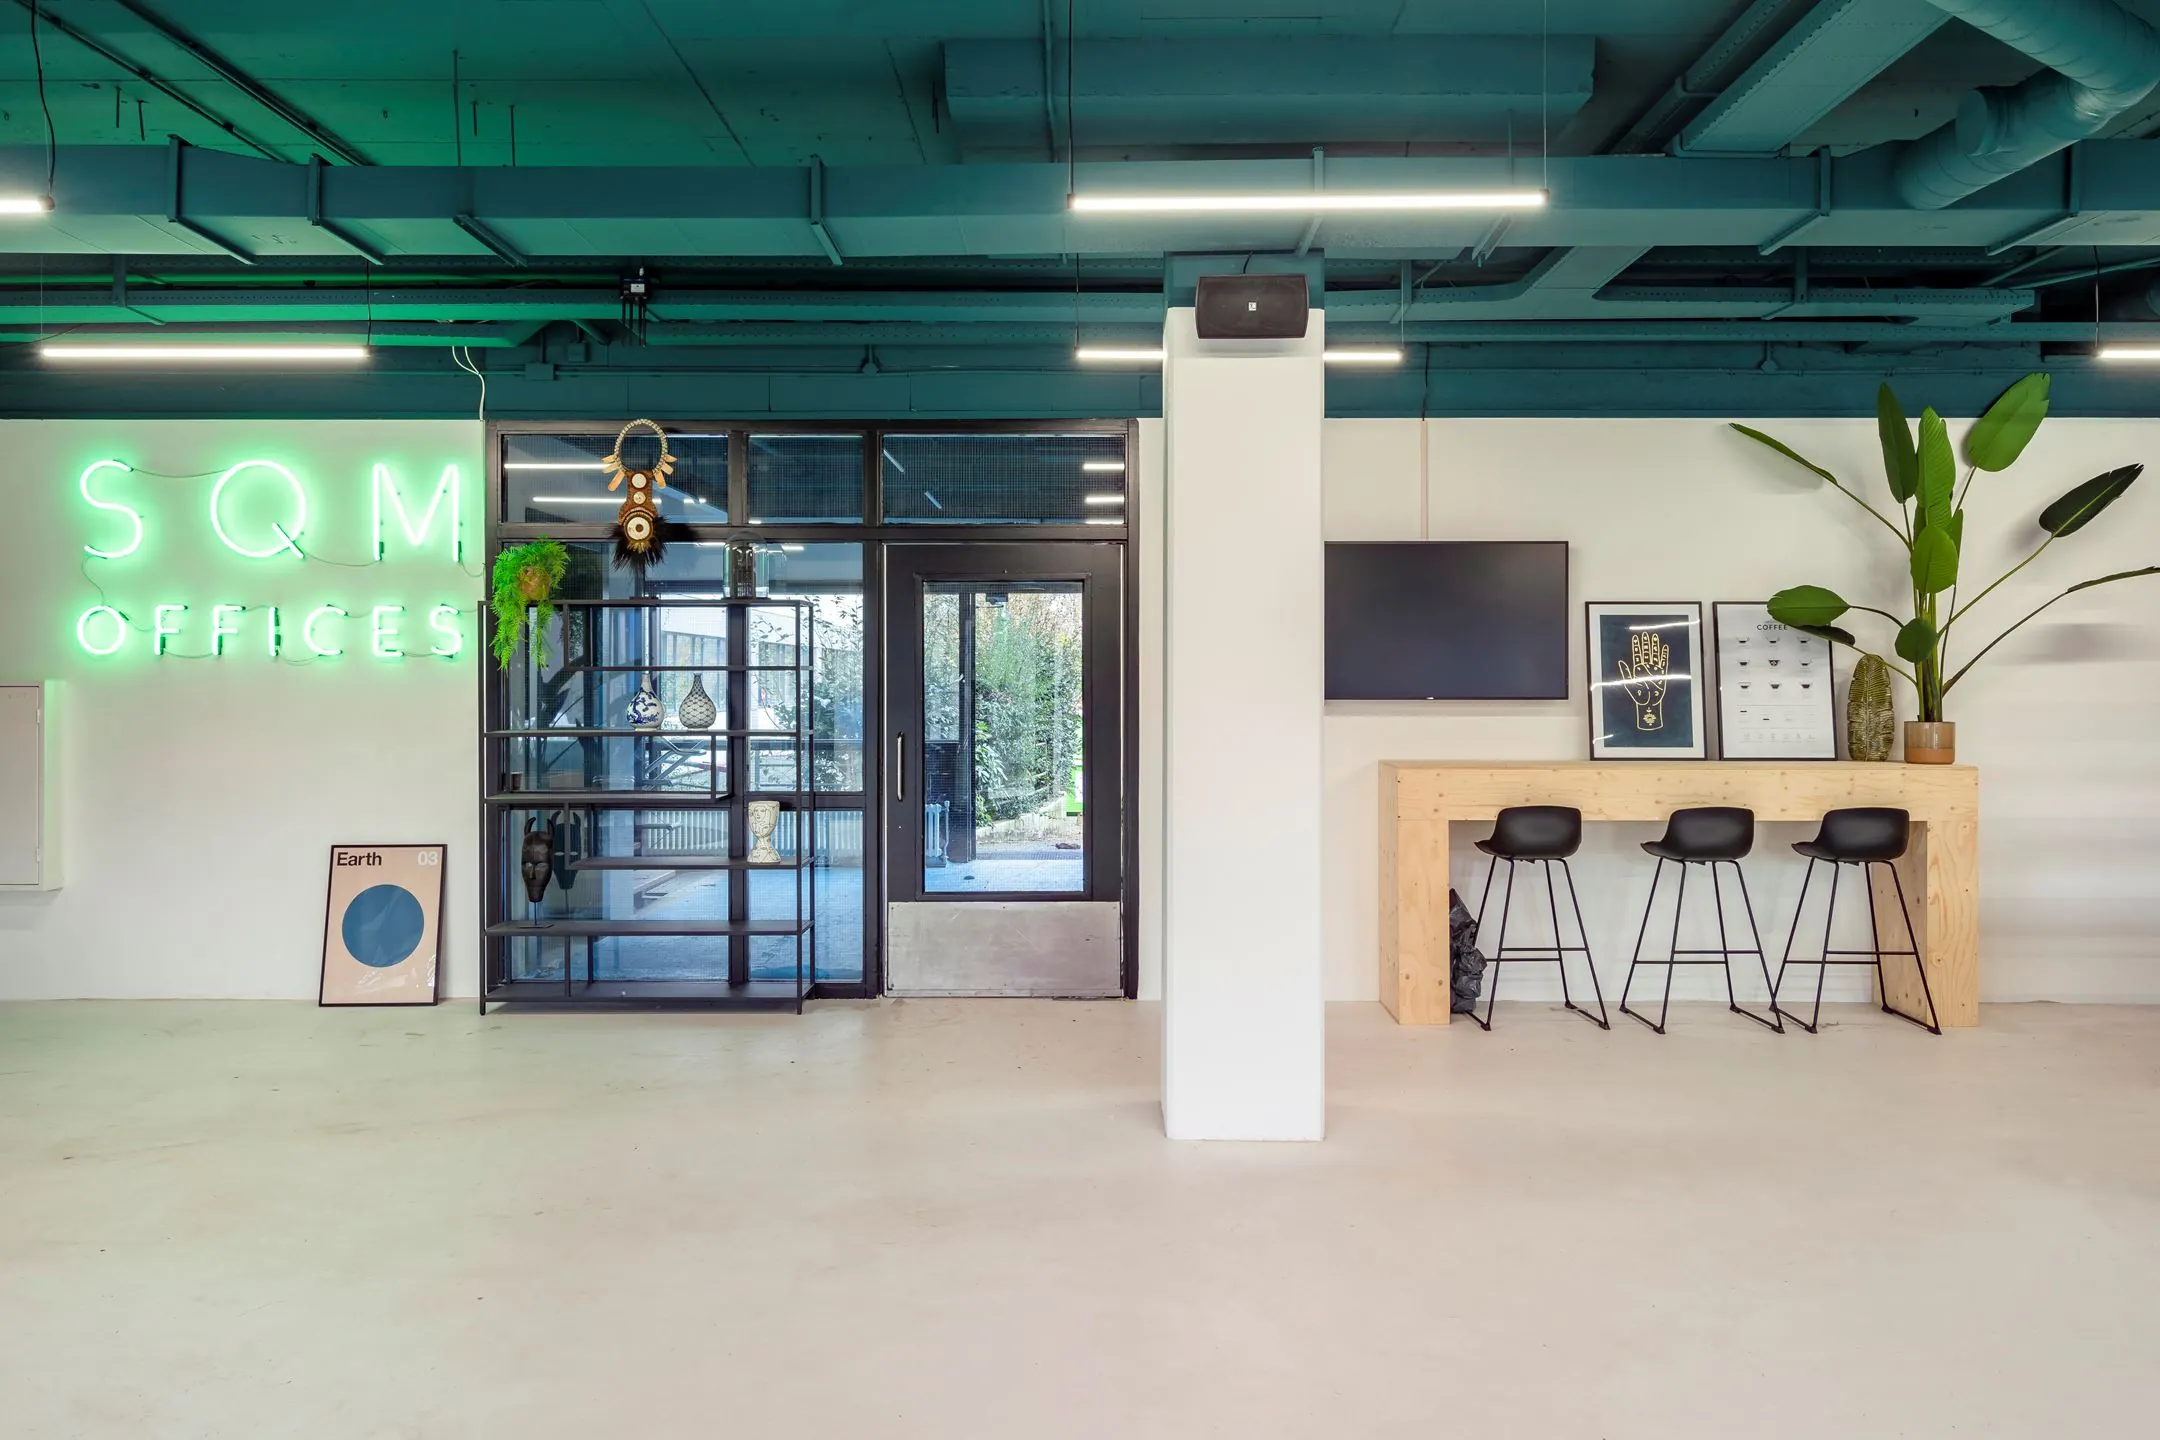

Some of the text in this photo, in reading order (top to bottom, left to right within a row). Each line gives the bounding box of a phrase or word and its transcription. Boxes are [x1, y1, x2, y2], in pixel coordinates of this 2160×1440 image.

[80, 459, 460, 562] SQM
[77, 604, 463, 656] OFFICES
[337, 851, 438, 866] Earth 03
